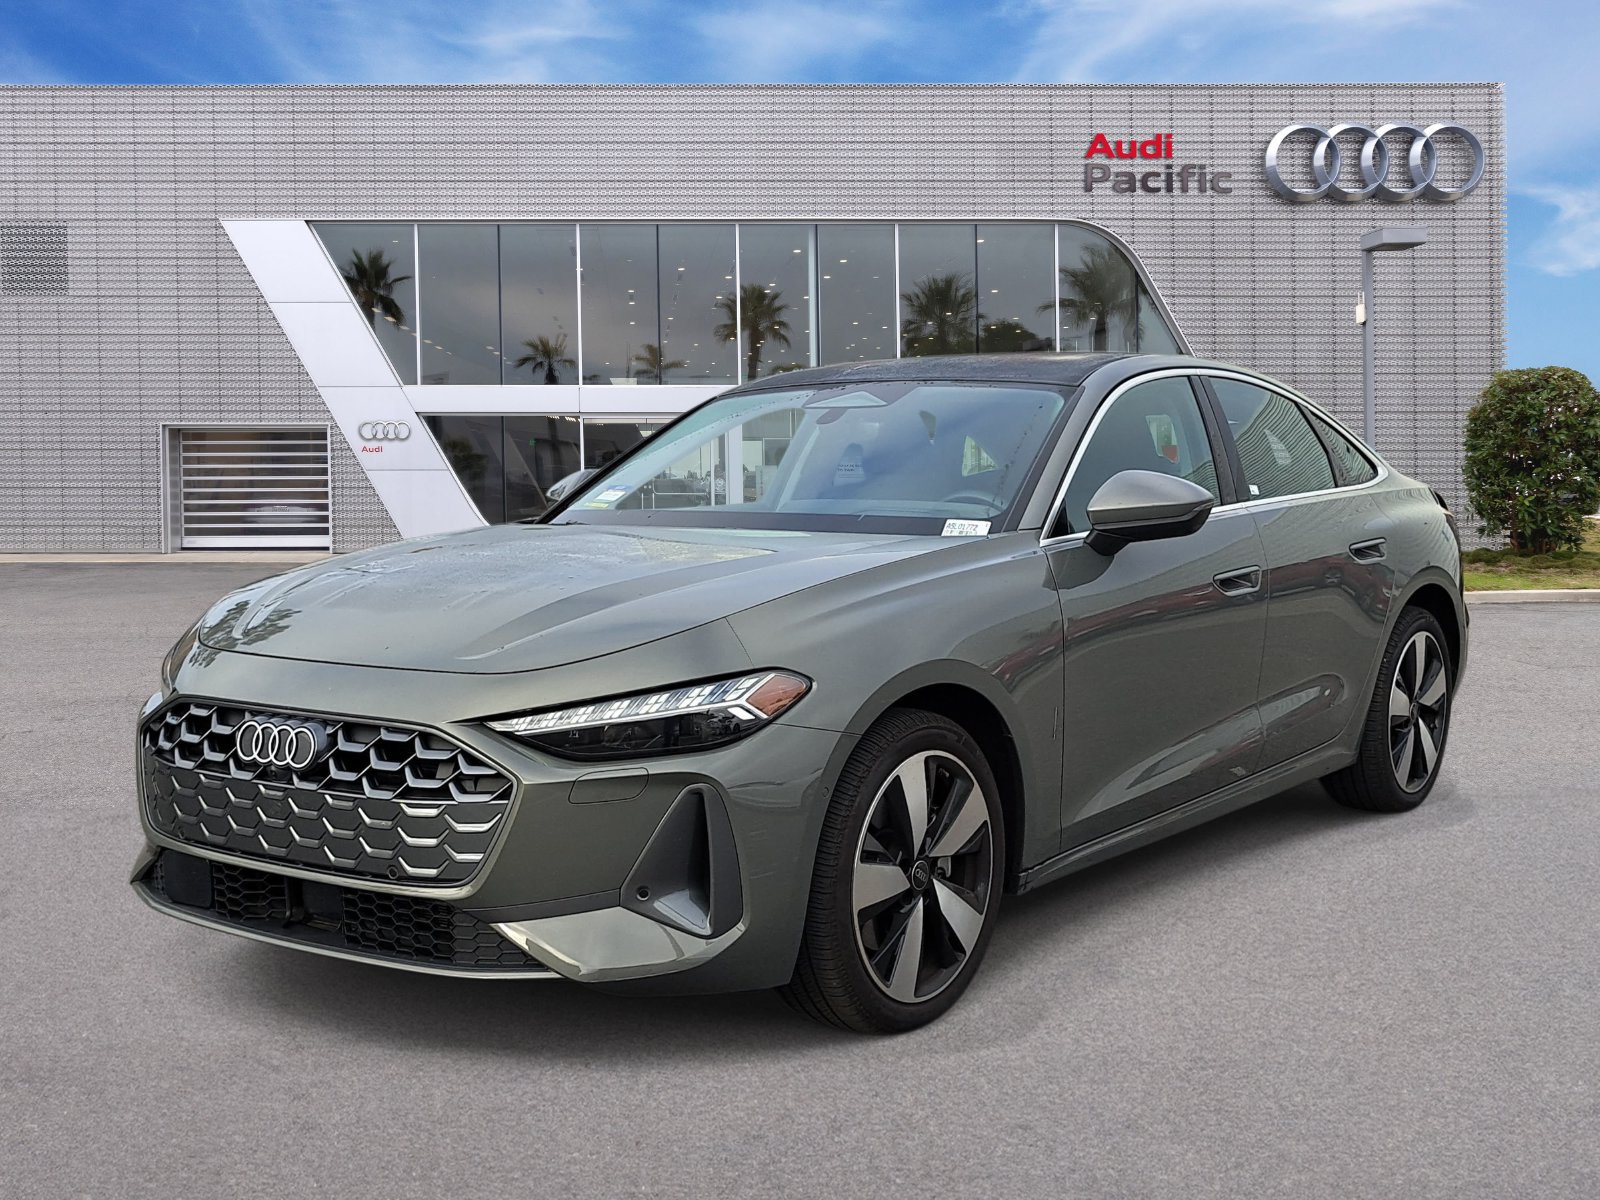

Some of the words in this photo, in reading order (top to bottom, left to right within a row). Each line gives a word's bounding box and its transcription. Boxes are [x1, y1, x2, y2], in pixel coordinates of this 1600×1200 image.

[1084, 133, 1173, 159] Audi
[1084, 163, 1233, 194] Pacific
[361, 445, 383, 453] Audi
